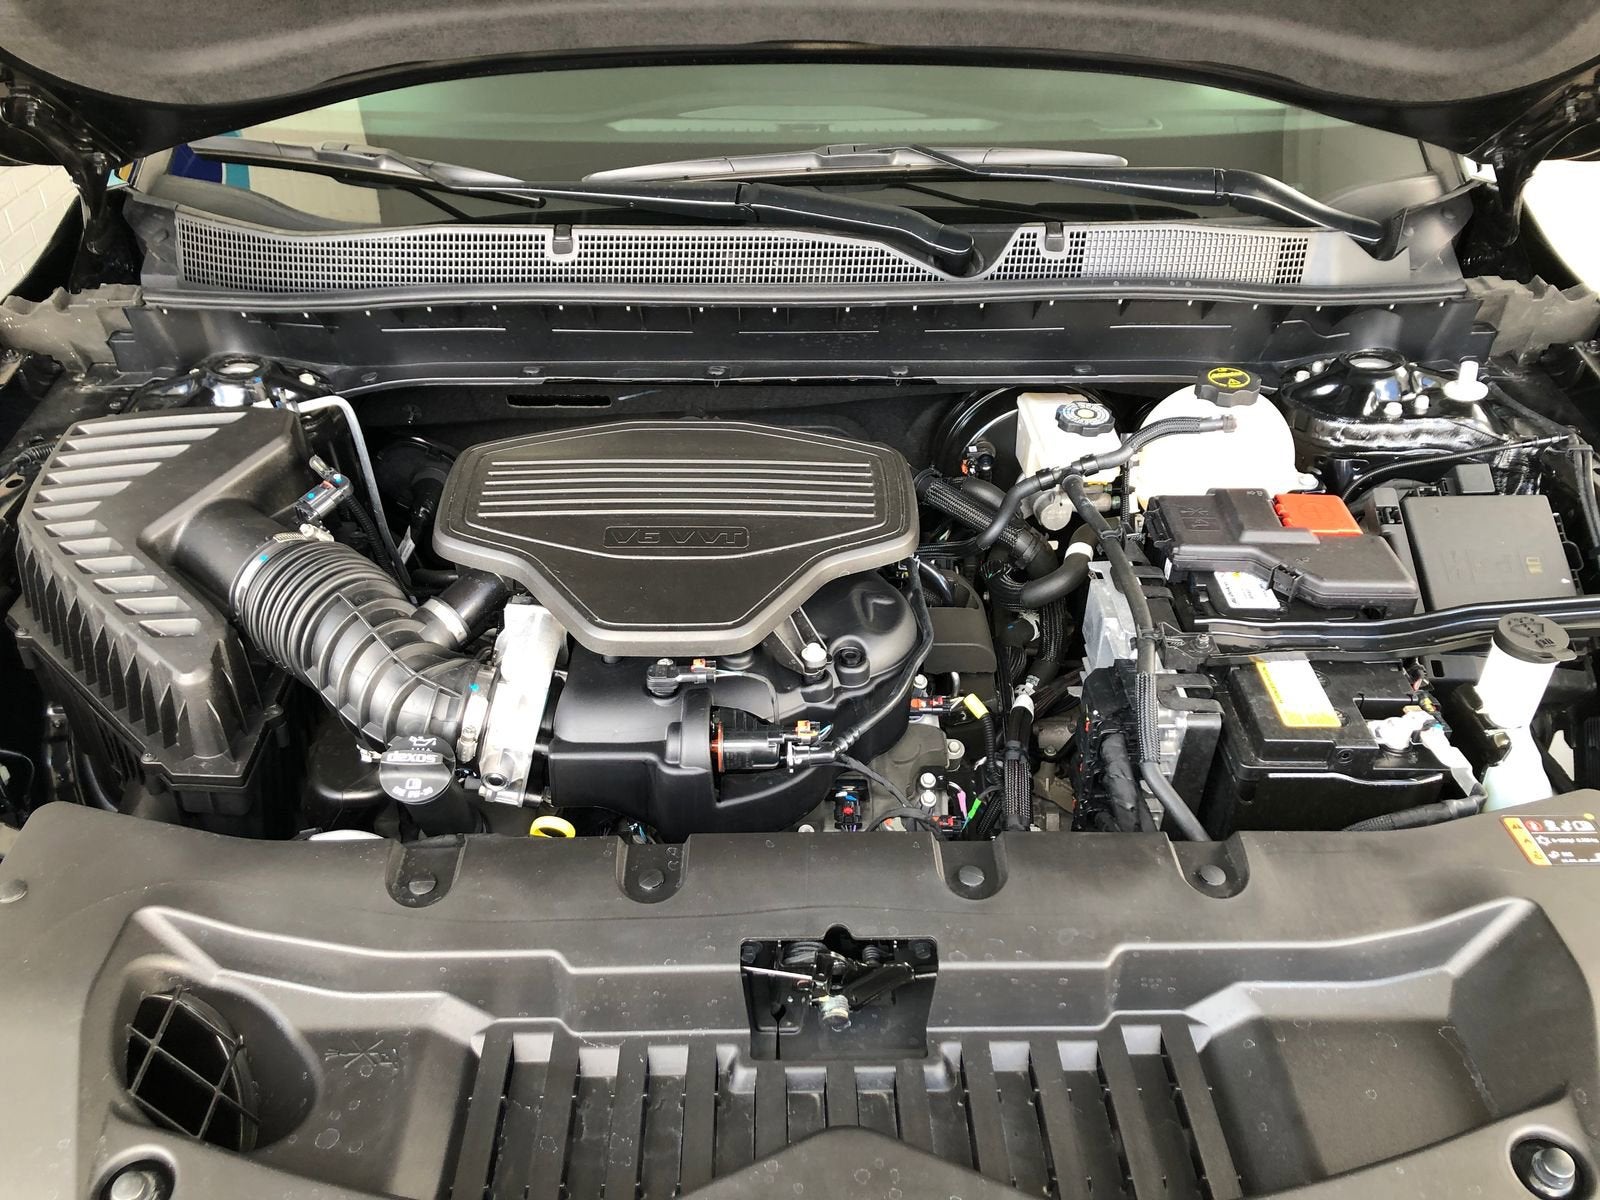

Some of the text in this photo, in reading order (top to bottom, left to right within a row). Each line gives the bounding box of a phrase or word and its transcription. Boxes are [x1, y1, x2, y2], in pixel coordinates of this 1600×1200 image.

[611, 529, 744, 544] V6 VVT
[386, 750, 438, 763] dexos
